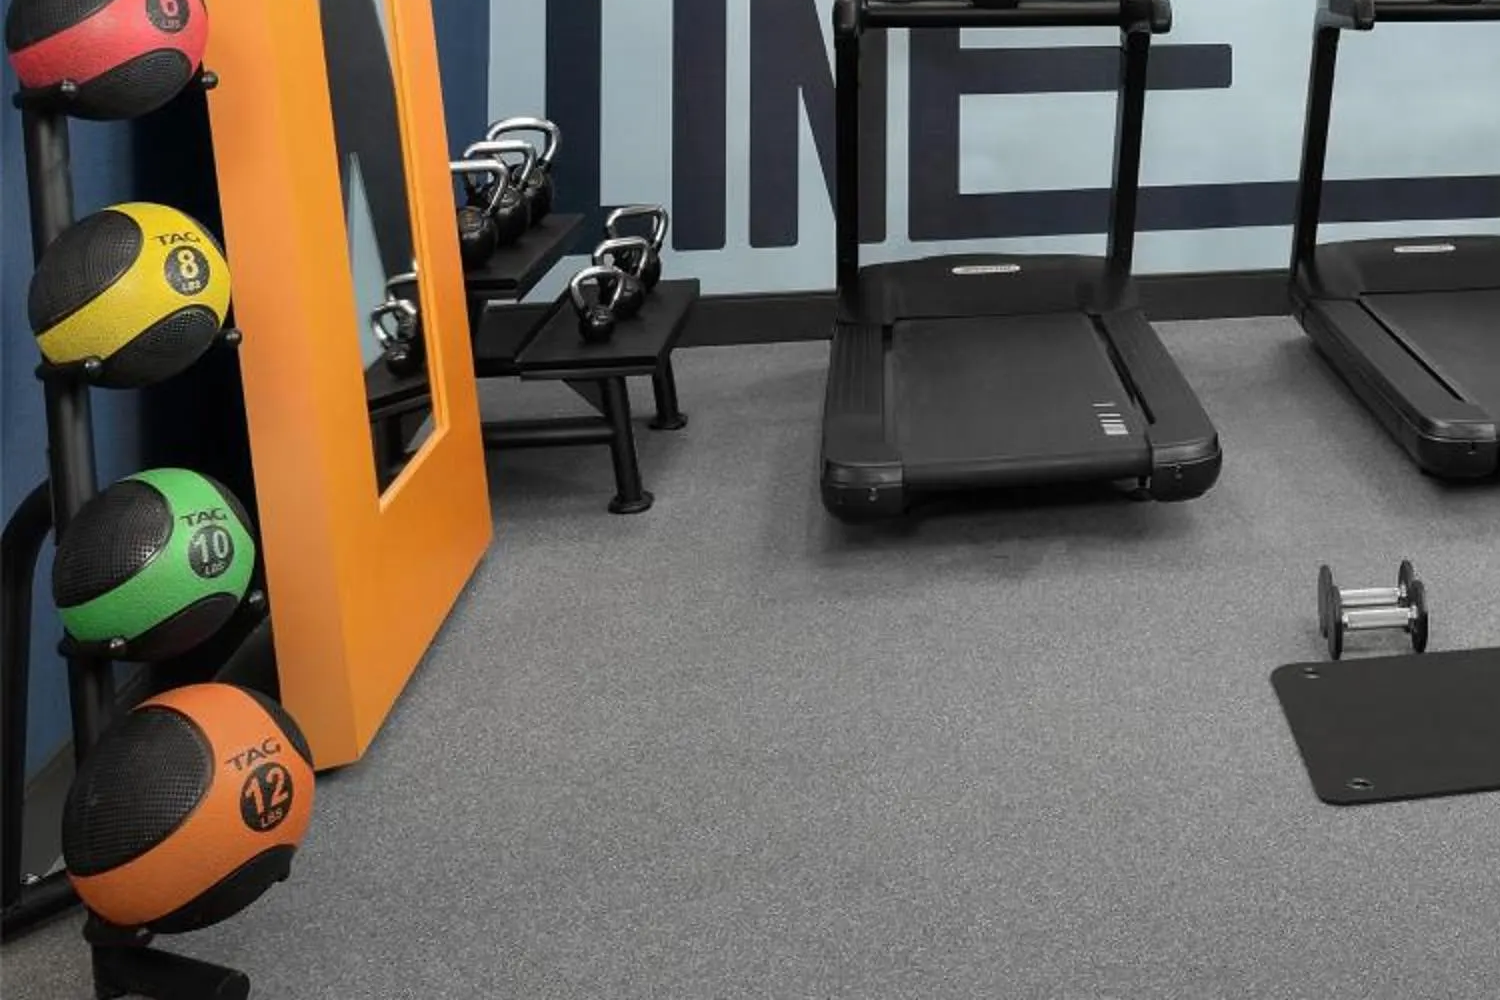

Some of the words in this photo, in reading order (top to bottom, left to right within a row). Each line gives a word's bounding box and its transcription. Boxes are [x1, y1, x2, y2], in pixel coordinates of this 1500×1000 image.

[149, 231, 201, 246] TAG
[177, 249, 199, 279] 8
[180, 507, 229, 527] TAG
[192, 530, 229, 563] 10
[223, 736, 282, 771] TAG
[245, 767, 289, 815] 12
